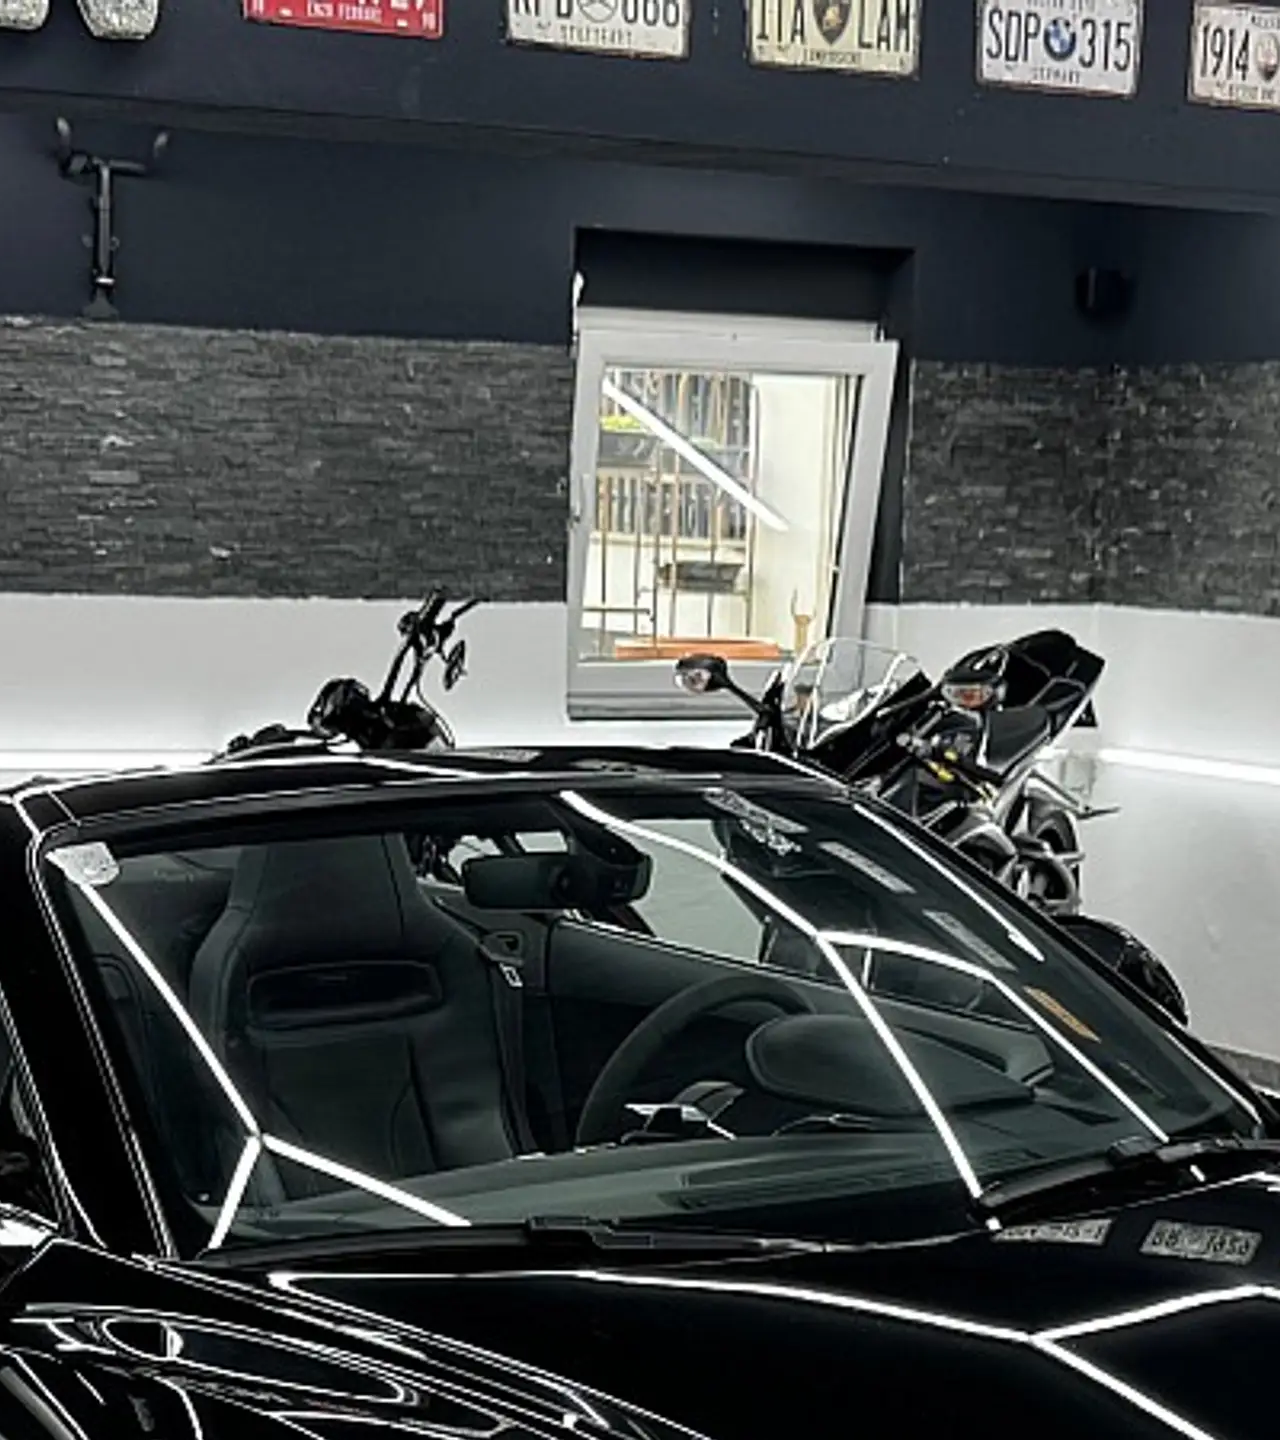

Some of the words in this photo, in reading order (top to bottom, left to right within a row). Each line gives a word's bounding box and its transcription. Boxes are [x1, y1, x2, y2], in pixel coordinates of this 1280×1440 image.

[985, 8, 1041, 63] SDP
[1078, 18, 1131, 72] 315
[1199, 22, 1250, 82] 1914
